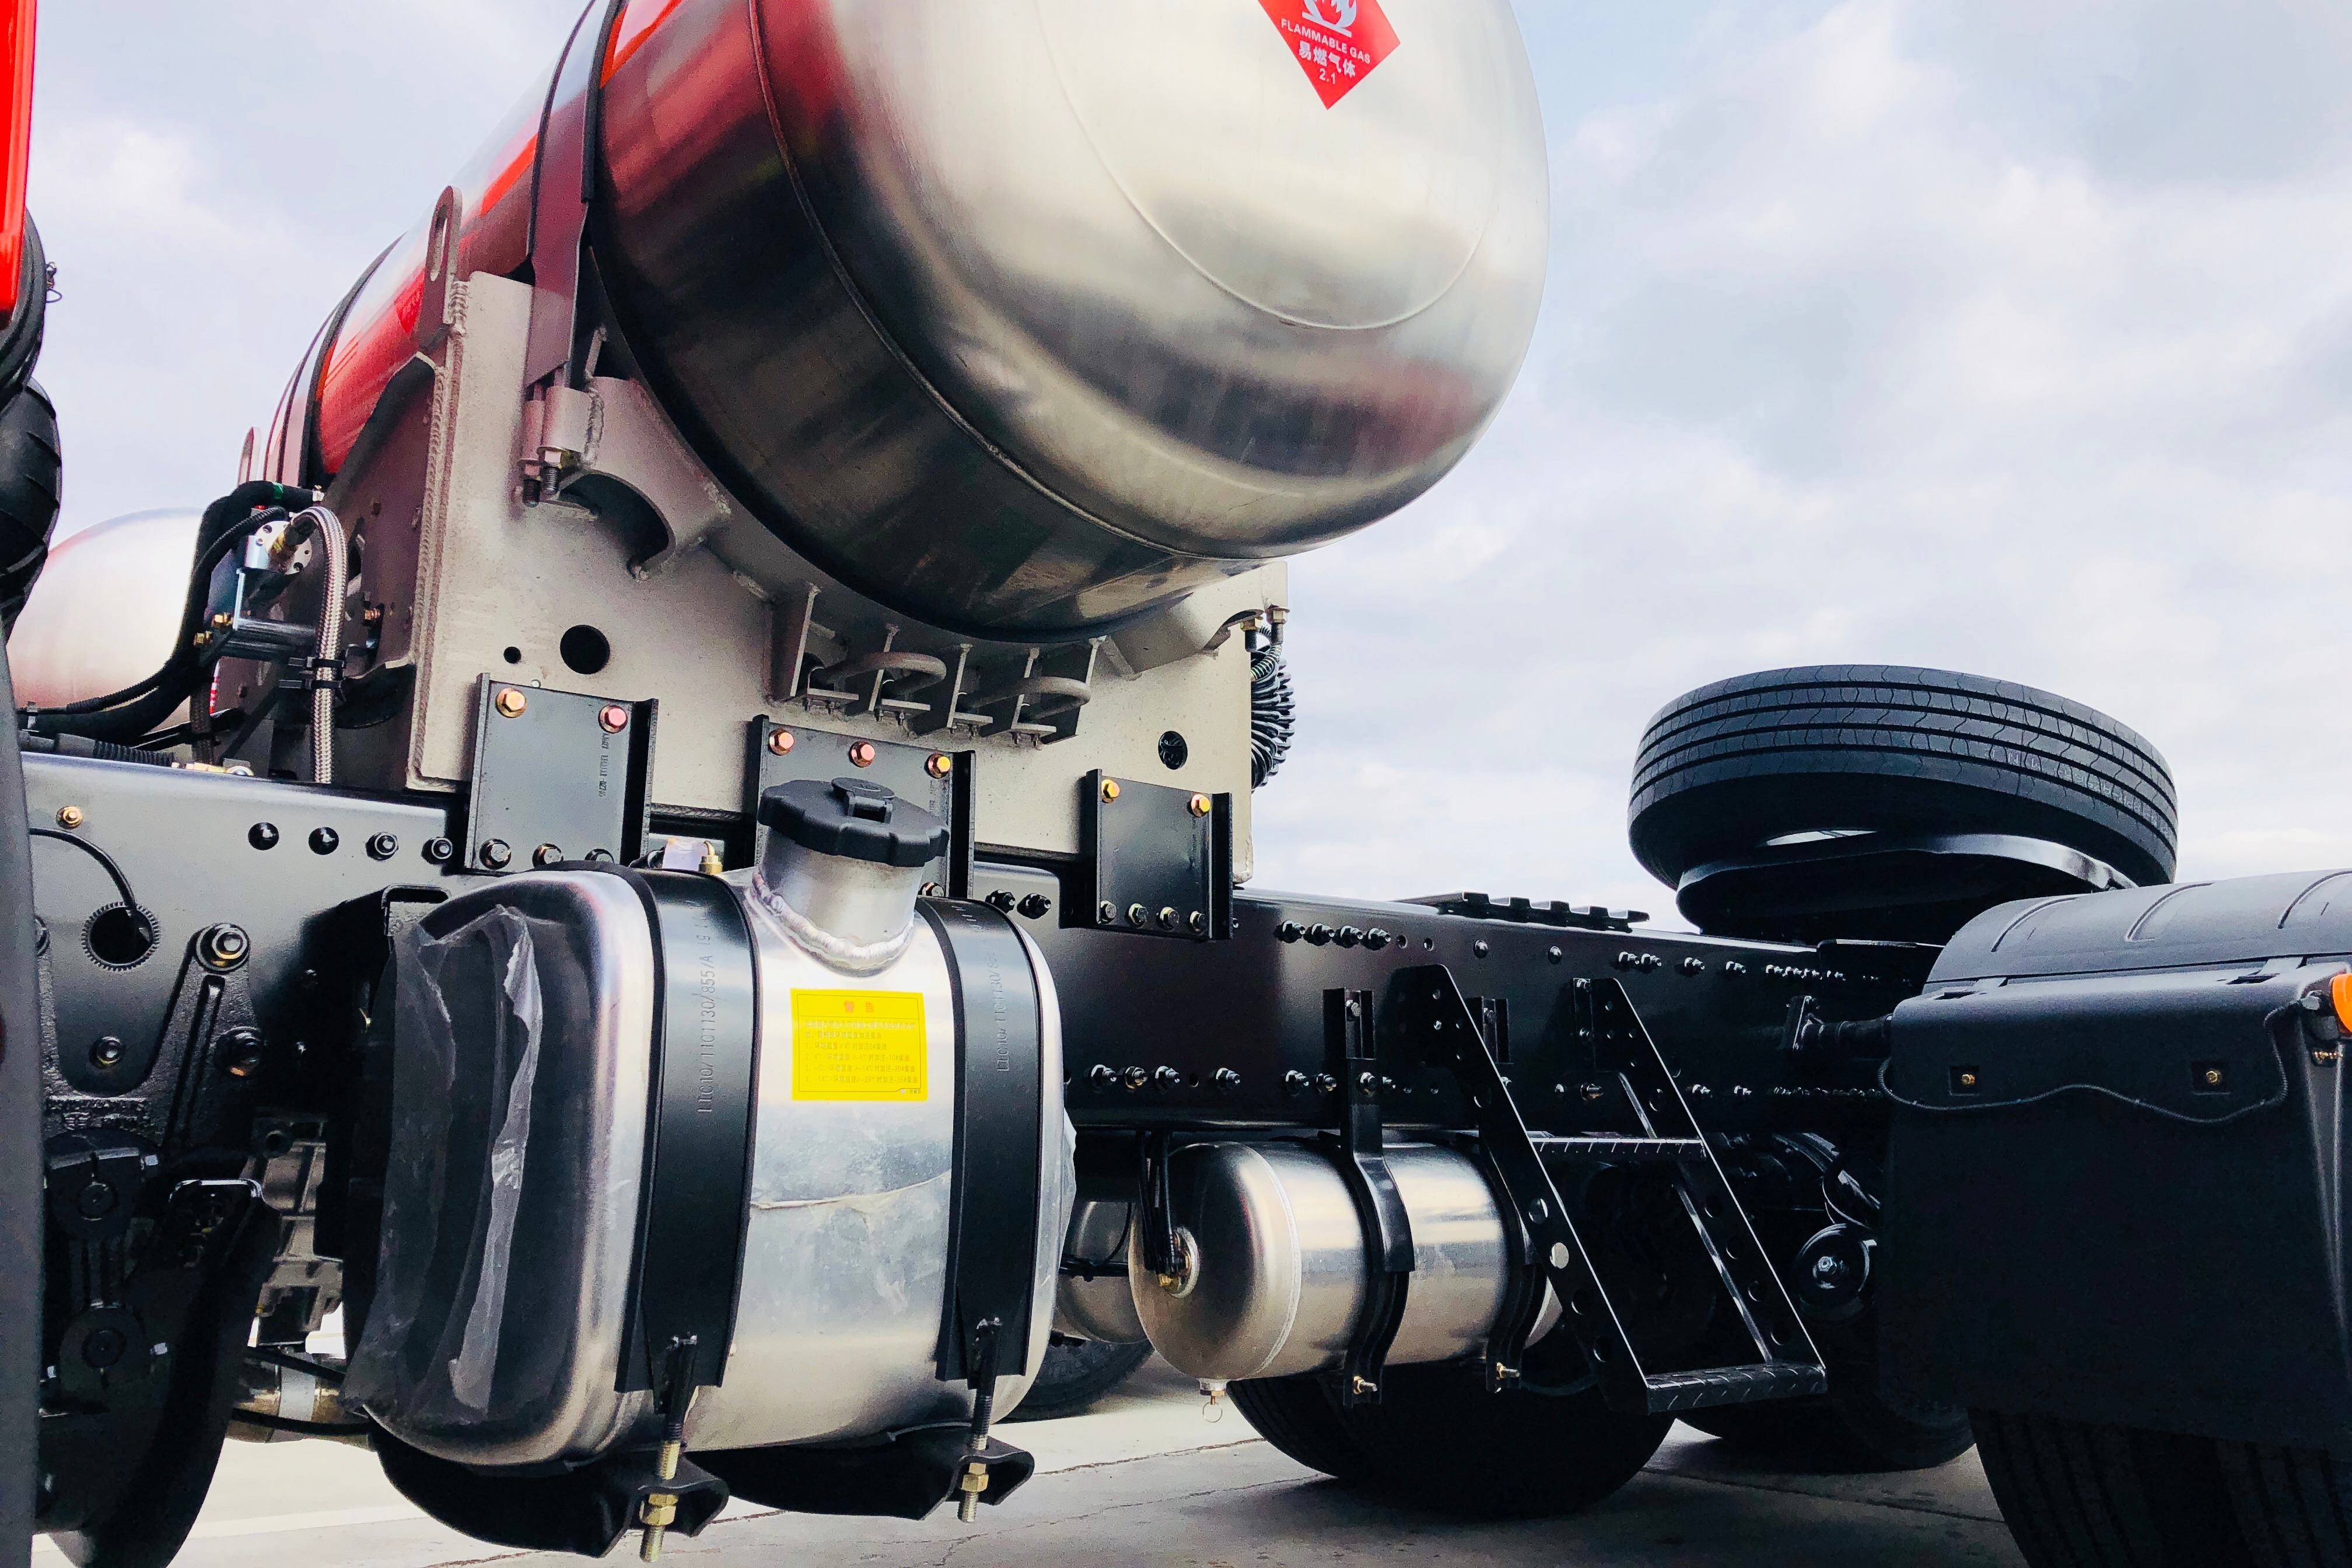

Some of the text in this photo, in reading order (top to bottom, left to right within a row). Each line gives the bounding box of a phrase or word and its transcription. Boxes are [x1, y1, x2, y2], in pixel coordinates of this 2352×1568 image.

[1280, 18, 1371, 64] FLAMMABLE GAS
[1298, 40, 1356, 78] 易燃气体
[1318, 68, 1336, 85] 2.1
